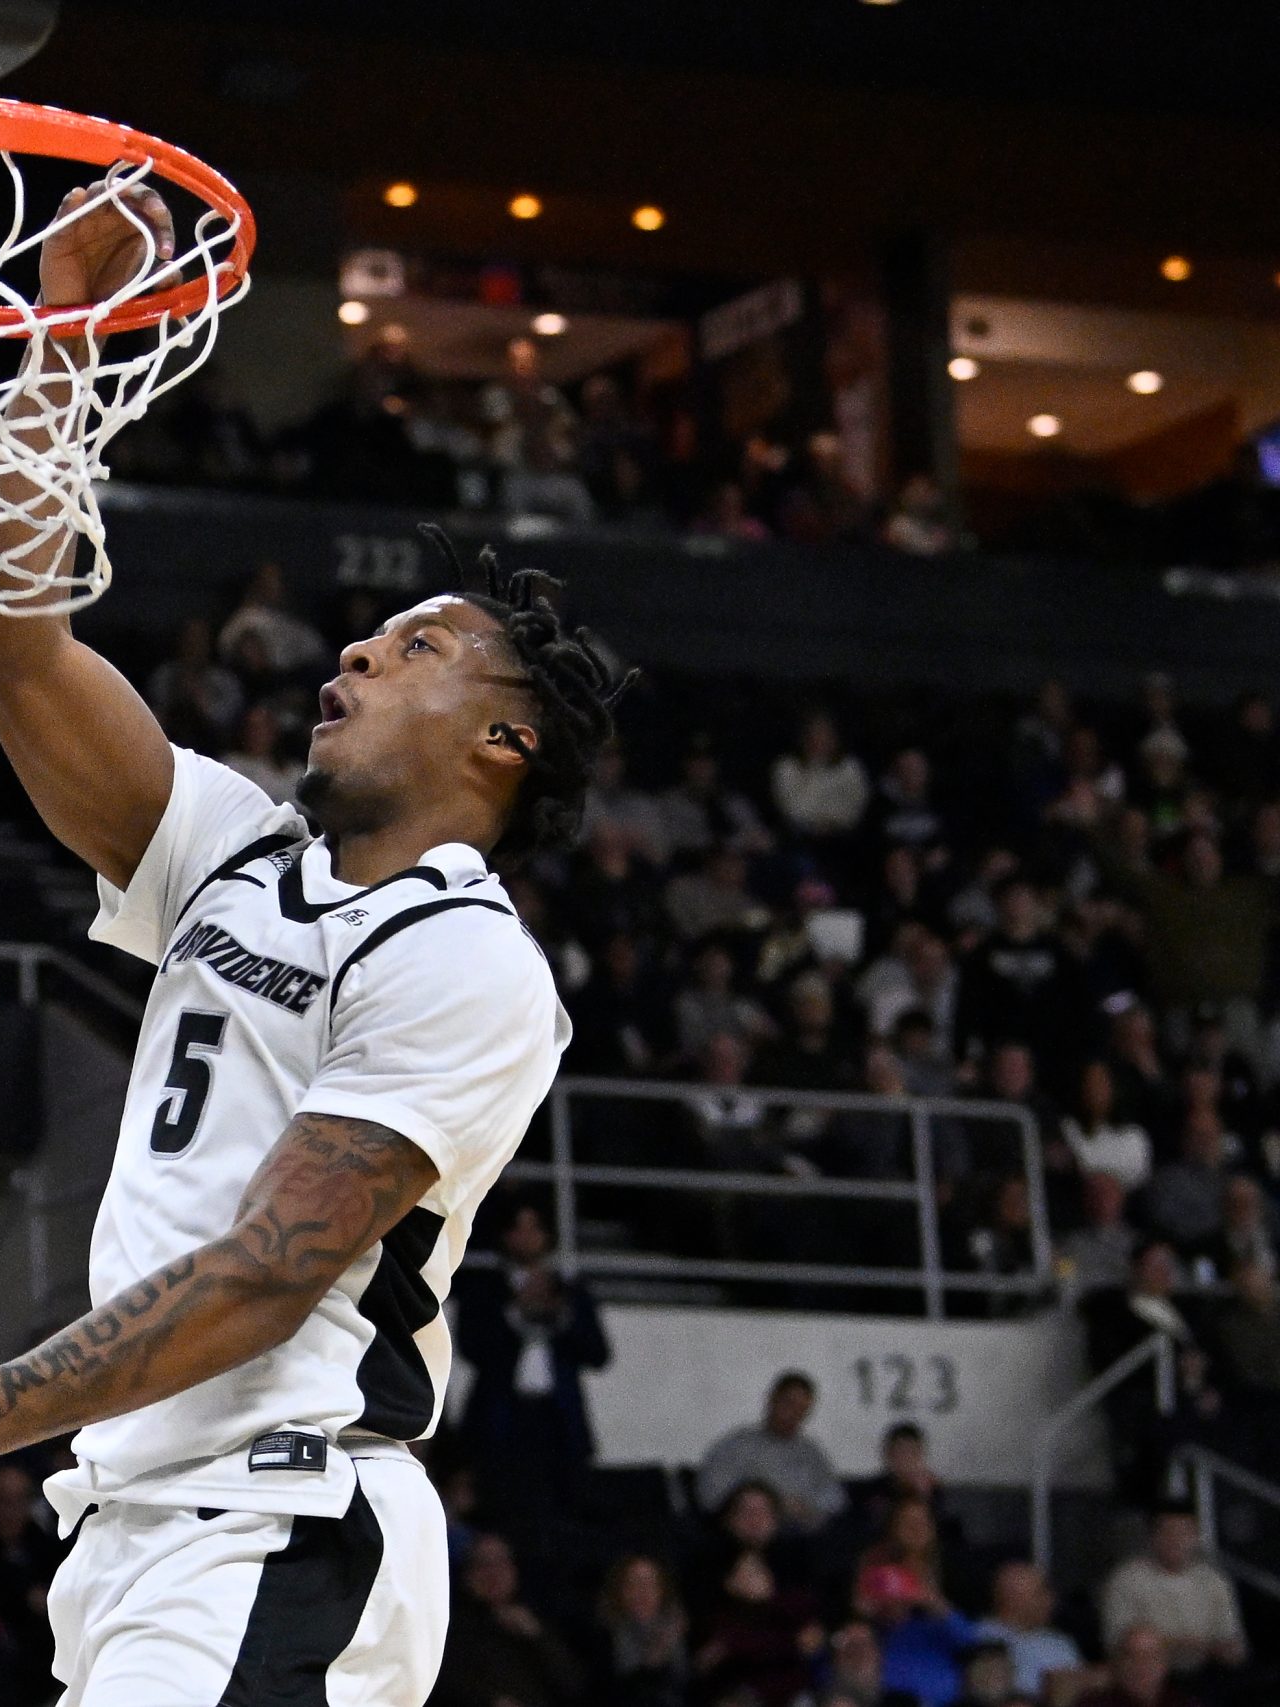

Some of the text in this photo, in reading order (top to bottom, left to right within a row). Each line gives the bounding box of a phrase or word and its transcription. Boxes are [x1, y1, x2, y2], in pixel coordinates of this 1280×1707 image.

[149, 1007, 231, 1160] 5
[852, 1353, 960, 1414] 123
[303, 1445, 313, 1460] L
